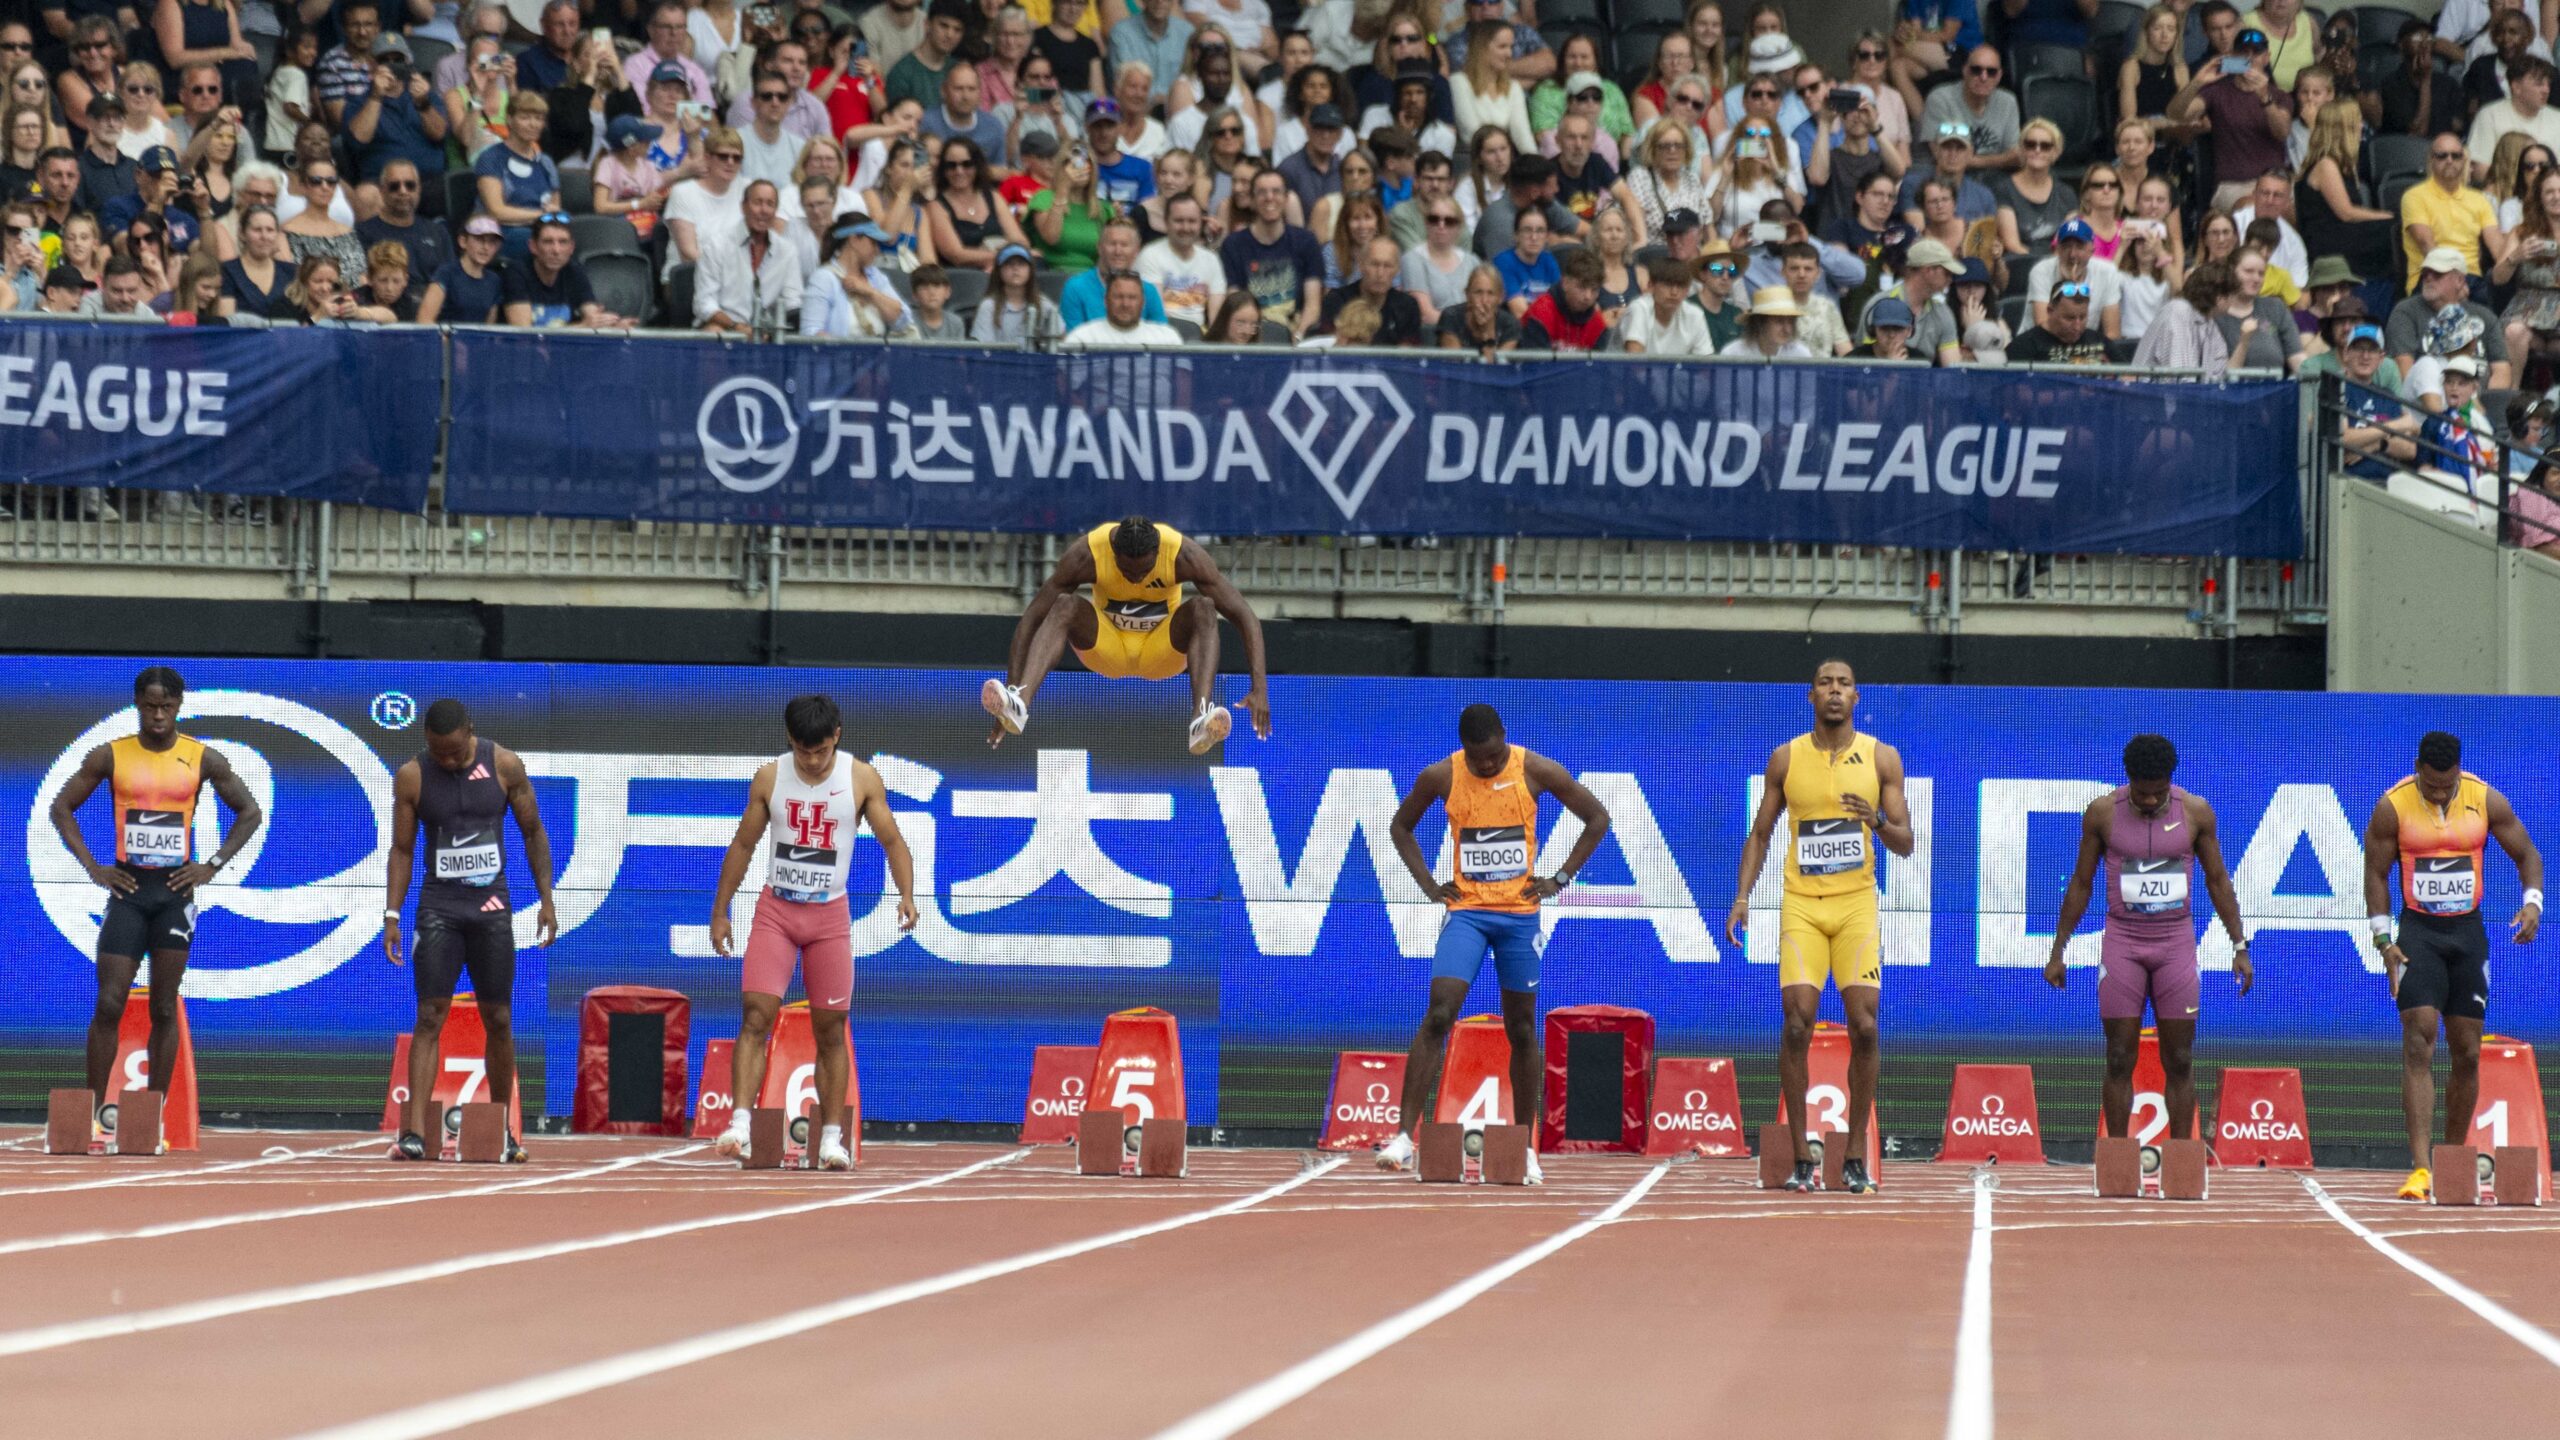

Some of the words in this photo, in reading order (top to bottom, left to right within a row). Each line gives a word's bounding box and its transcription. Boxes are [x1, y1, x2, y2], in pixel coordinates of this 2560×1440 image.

[808, 398, 974, 482] 万达
[979, 404, 1271, 482] WANDA
[1425, 413, 1762, 487] DIAMOND
[1779, 422, 2067, 498] LEAGUE
[126, 832, 134, 848] A
[136, 832, 182, 850] BLAKE
[1802, 840, 1861, 860] HUGHES
[440, 851, 498, 872] SIMBINE
[1464, 848, 1524, 867] TEBOGO
[776, 865, 832, 889] HINCHLIFFE
[2416, 881, 2426, 896] Y
[2428, 879, 2473, 896] BLAKE
[2139, 881, 2169, 897] AZU
[444, 1058, 487, 1105] 7
[785, 1064, 820, 1121] 6
[1111, 1071, 1155, 1127] 5
[1457, 1076, 1507, 1130] 4
[1336, 1104, 1401, 1124] OMEG
[1654, 1112, 1737, 1132] OMEGA
[1805, 1084, 1850, 1140] 3
[2131, 1092, 2170, 1149] 2
[1952, 1117, 2034, 1136] OMEGA
[2222, 1121, 2304, 1140] OMEGA
[2476, 1100, 2508, 1149] 1
